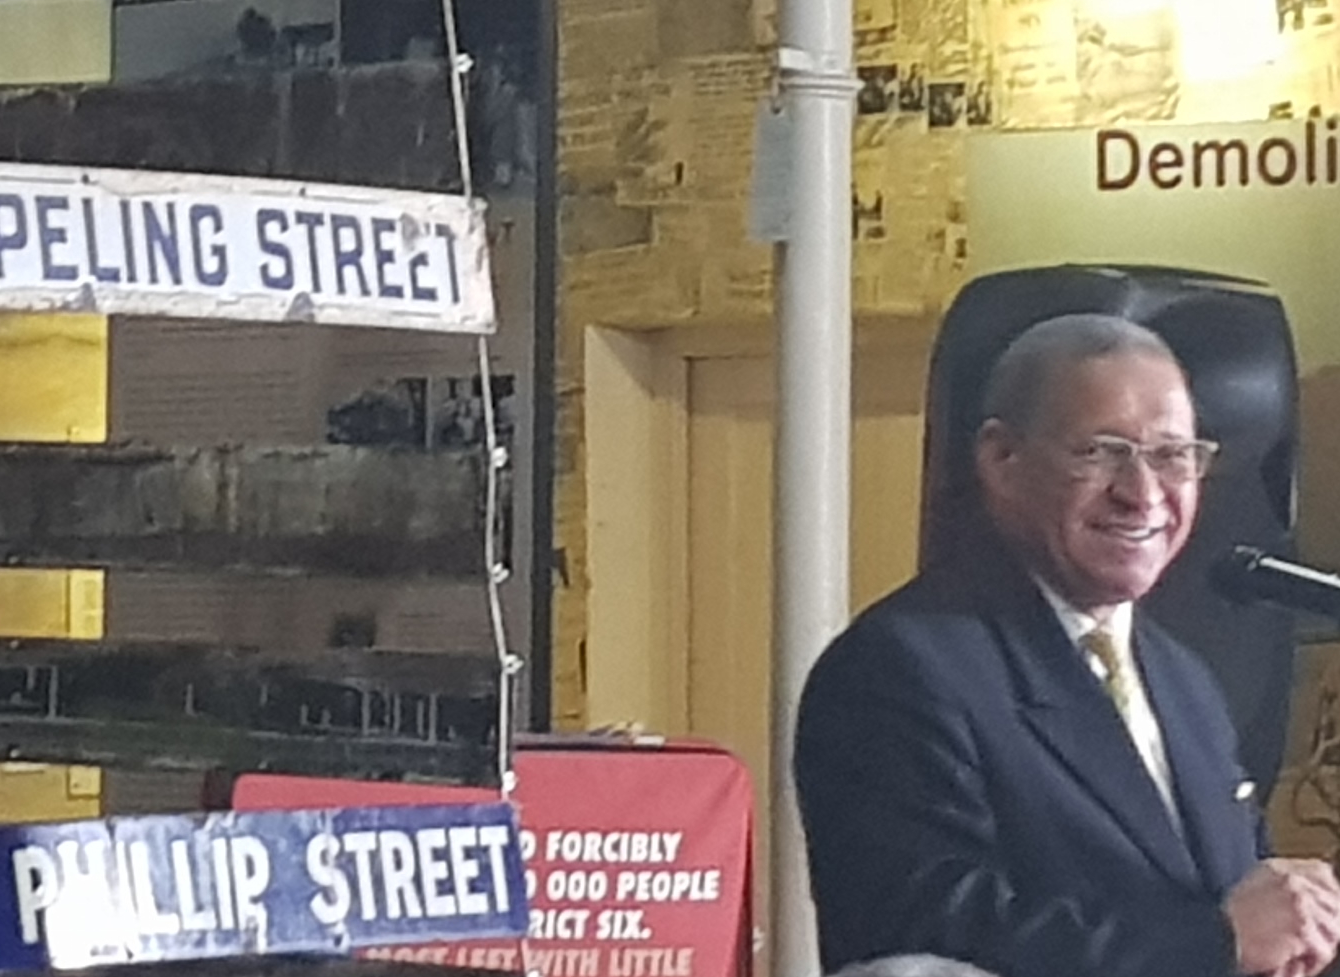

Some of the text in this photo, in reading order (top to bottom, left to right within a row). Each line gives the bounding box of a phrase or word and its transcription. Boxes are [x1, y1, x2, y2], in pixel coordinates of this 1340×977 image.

[258, 206, 463, 305] STREET
[546, 831, 682, 862] FORCIBLY
[306, 825, 510, 925] STREET
[547, 870, 607, 901] 000
[616, 870, 720, 901] PEOPLE
[596, 910, 652, 939] SIX.
[612, 948, 694, 977] LITTLE
